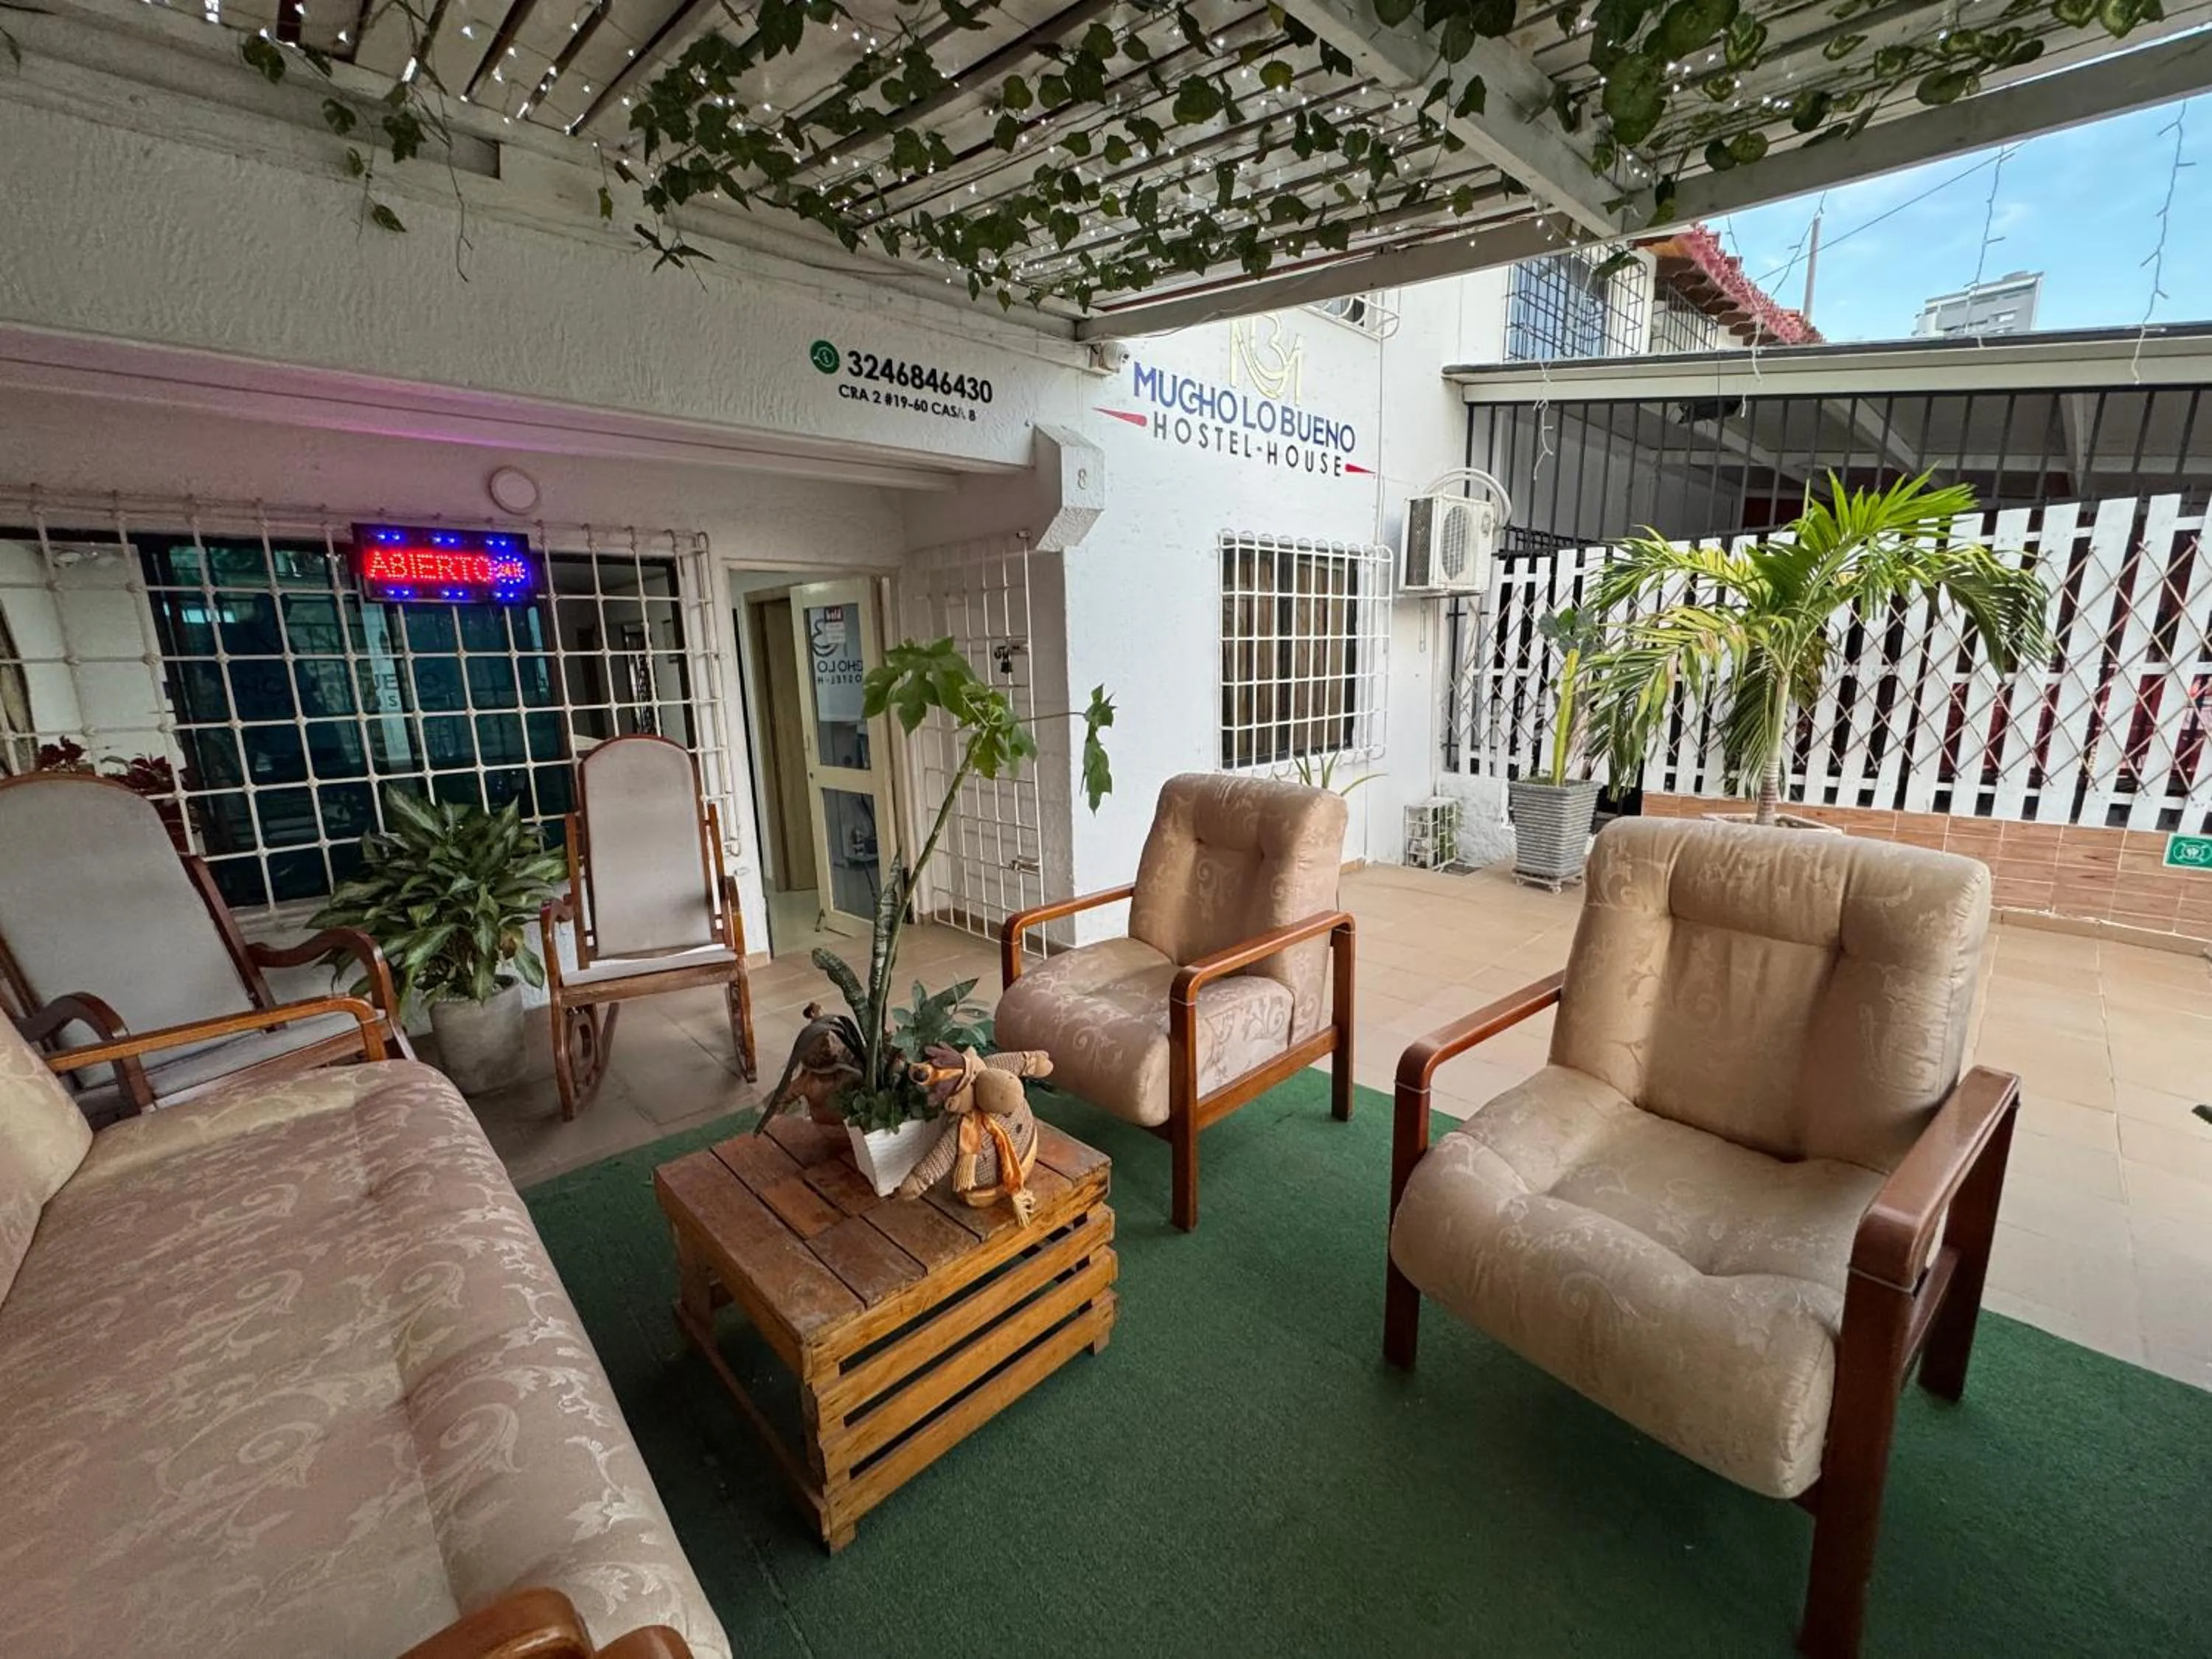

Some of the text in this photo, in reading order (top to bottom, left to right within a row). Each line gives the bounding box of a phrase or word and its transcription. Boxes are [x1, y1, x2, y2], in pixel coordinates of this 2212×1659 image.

[848, 350, 993, 403] 3246846430
[839, 384, 869, 402] CRA
[873, 390, 882, 404] 2
[885, 392, 928, 413] #19-60
[1280, 405, 1355, 453] BUENO
[369, 551, 493, 582] ABIERTO
